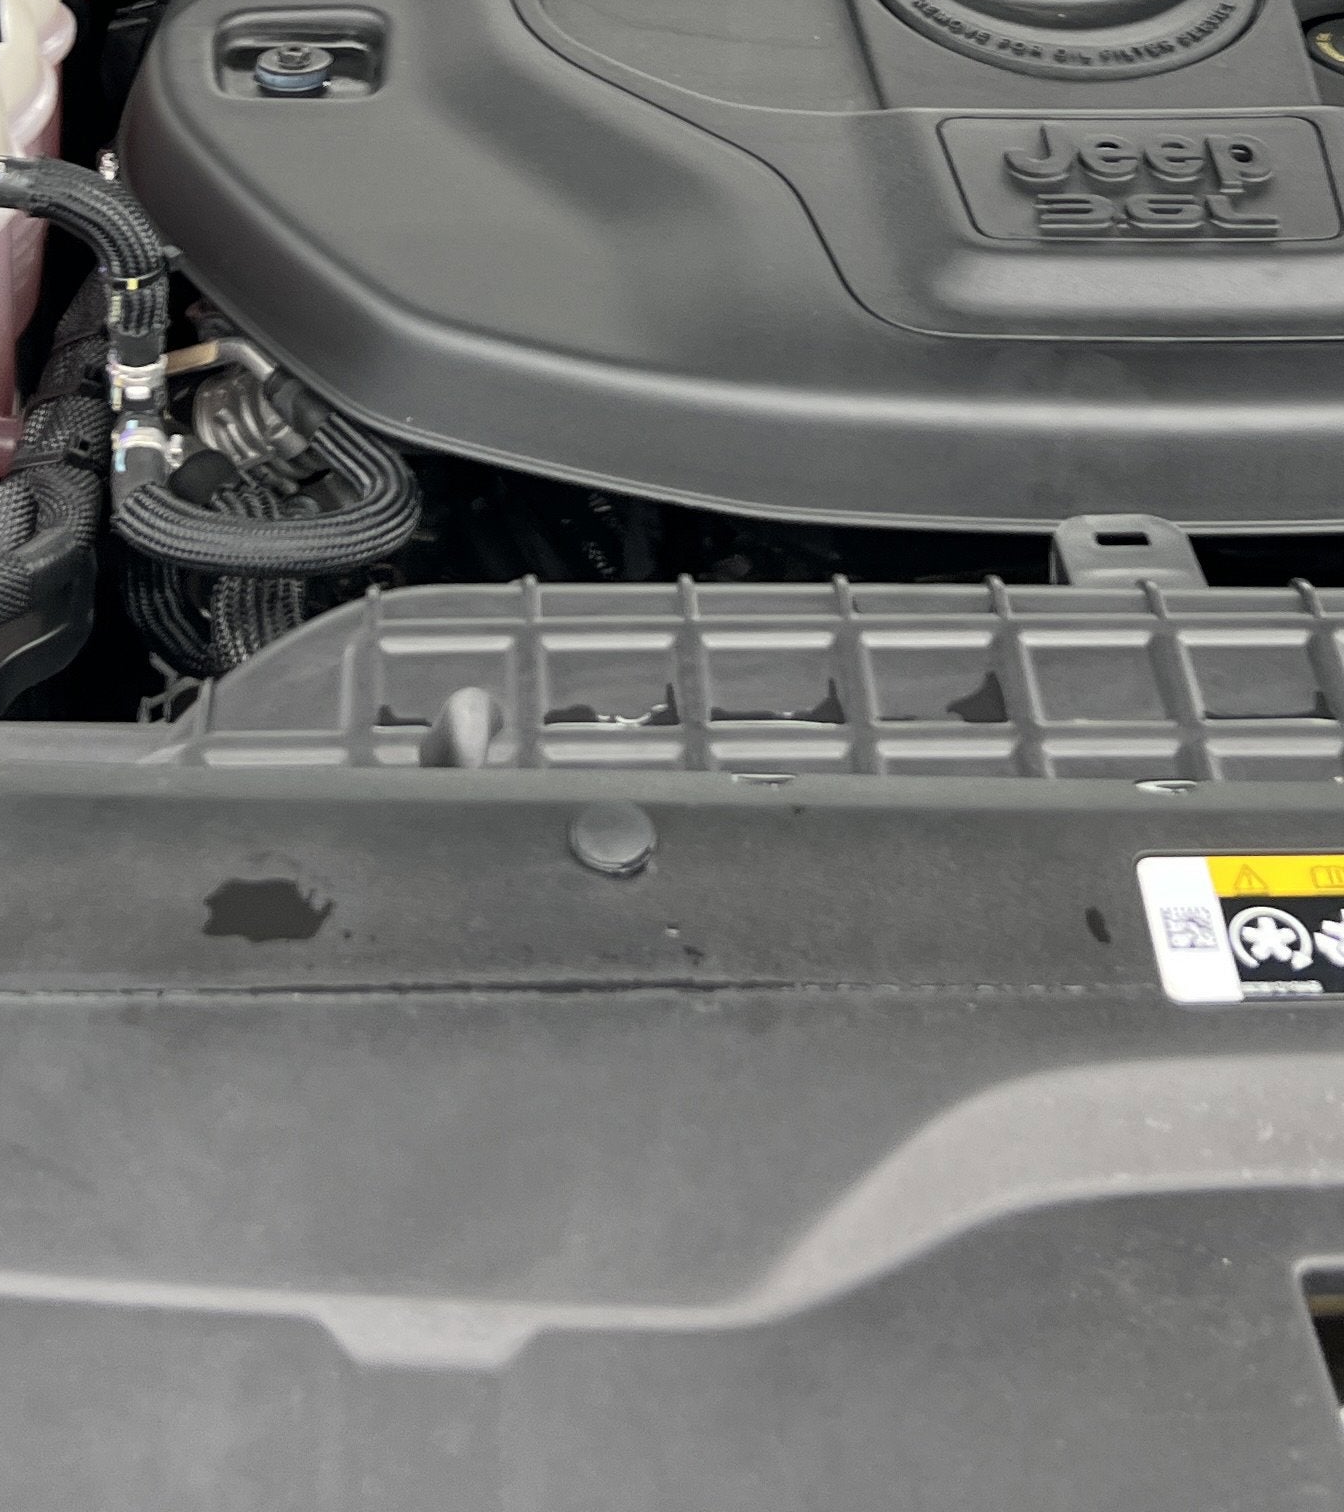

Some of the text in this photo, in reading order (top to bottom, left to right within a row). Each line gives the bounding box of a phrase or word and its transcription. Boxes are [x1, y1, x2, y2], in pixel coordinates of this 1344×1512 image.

[996, 37, 1042, 58] FOR
[1052, 48, 1092, 66] OIL
[1098, 40, 1175, 64] FILTER
[1002, 122, 1274, 194] Jeep
[1033, 193, 1280, 231] 3.6L
